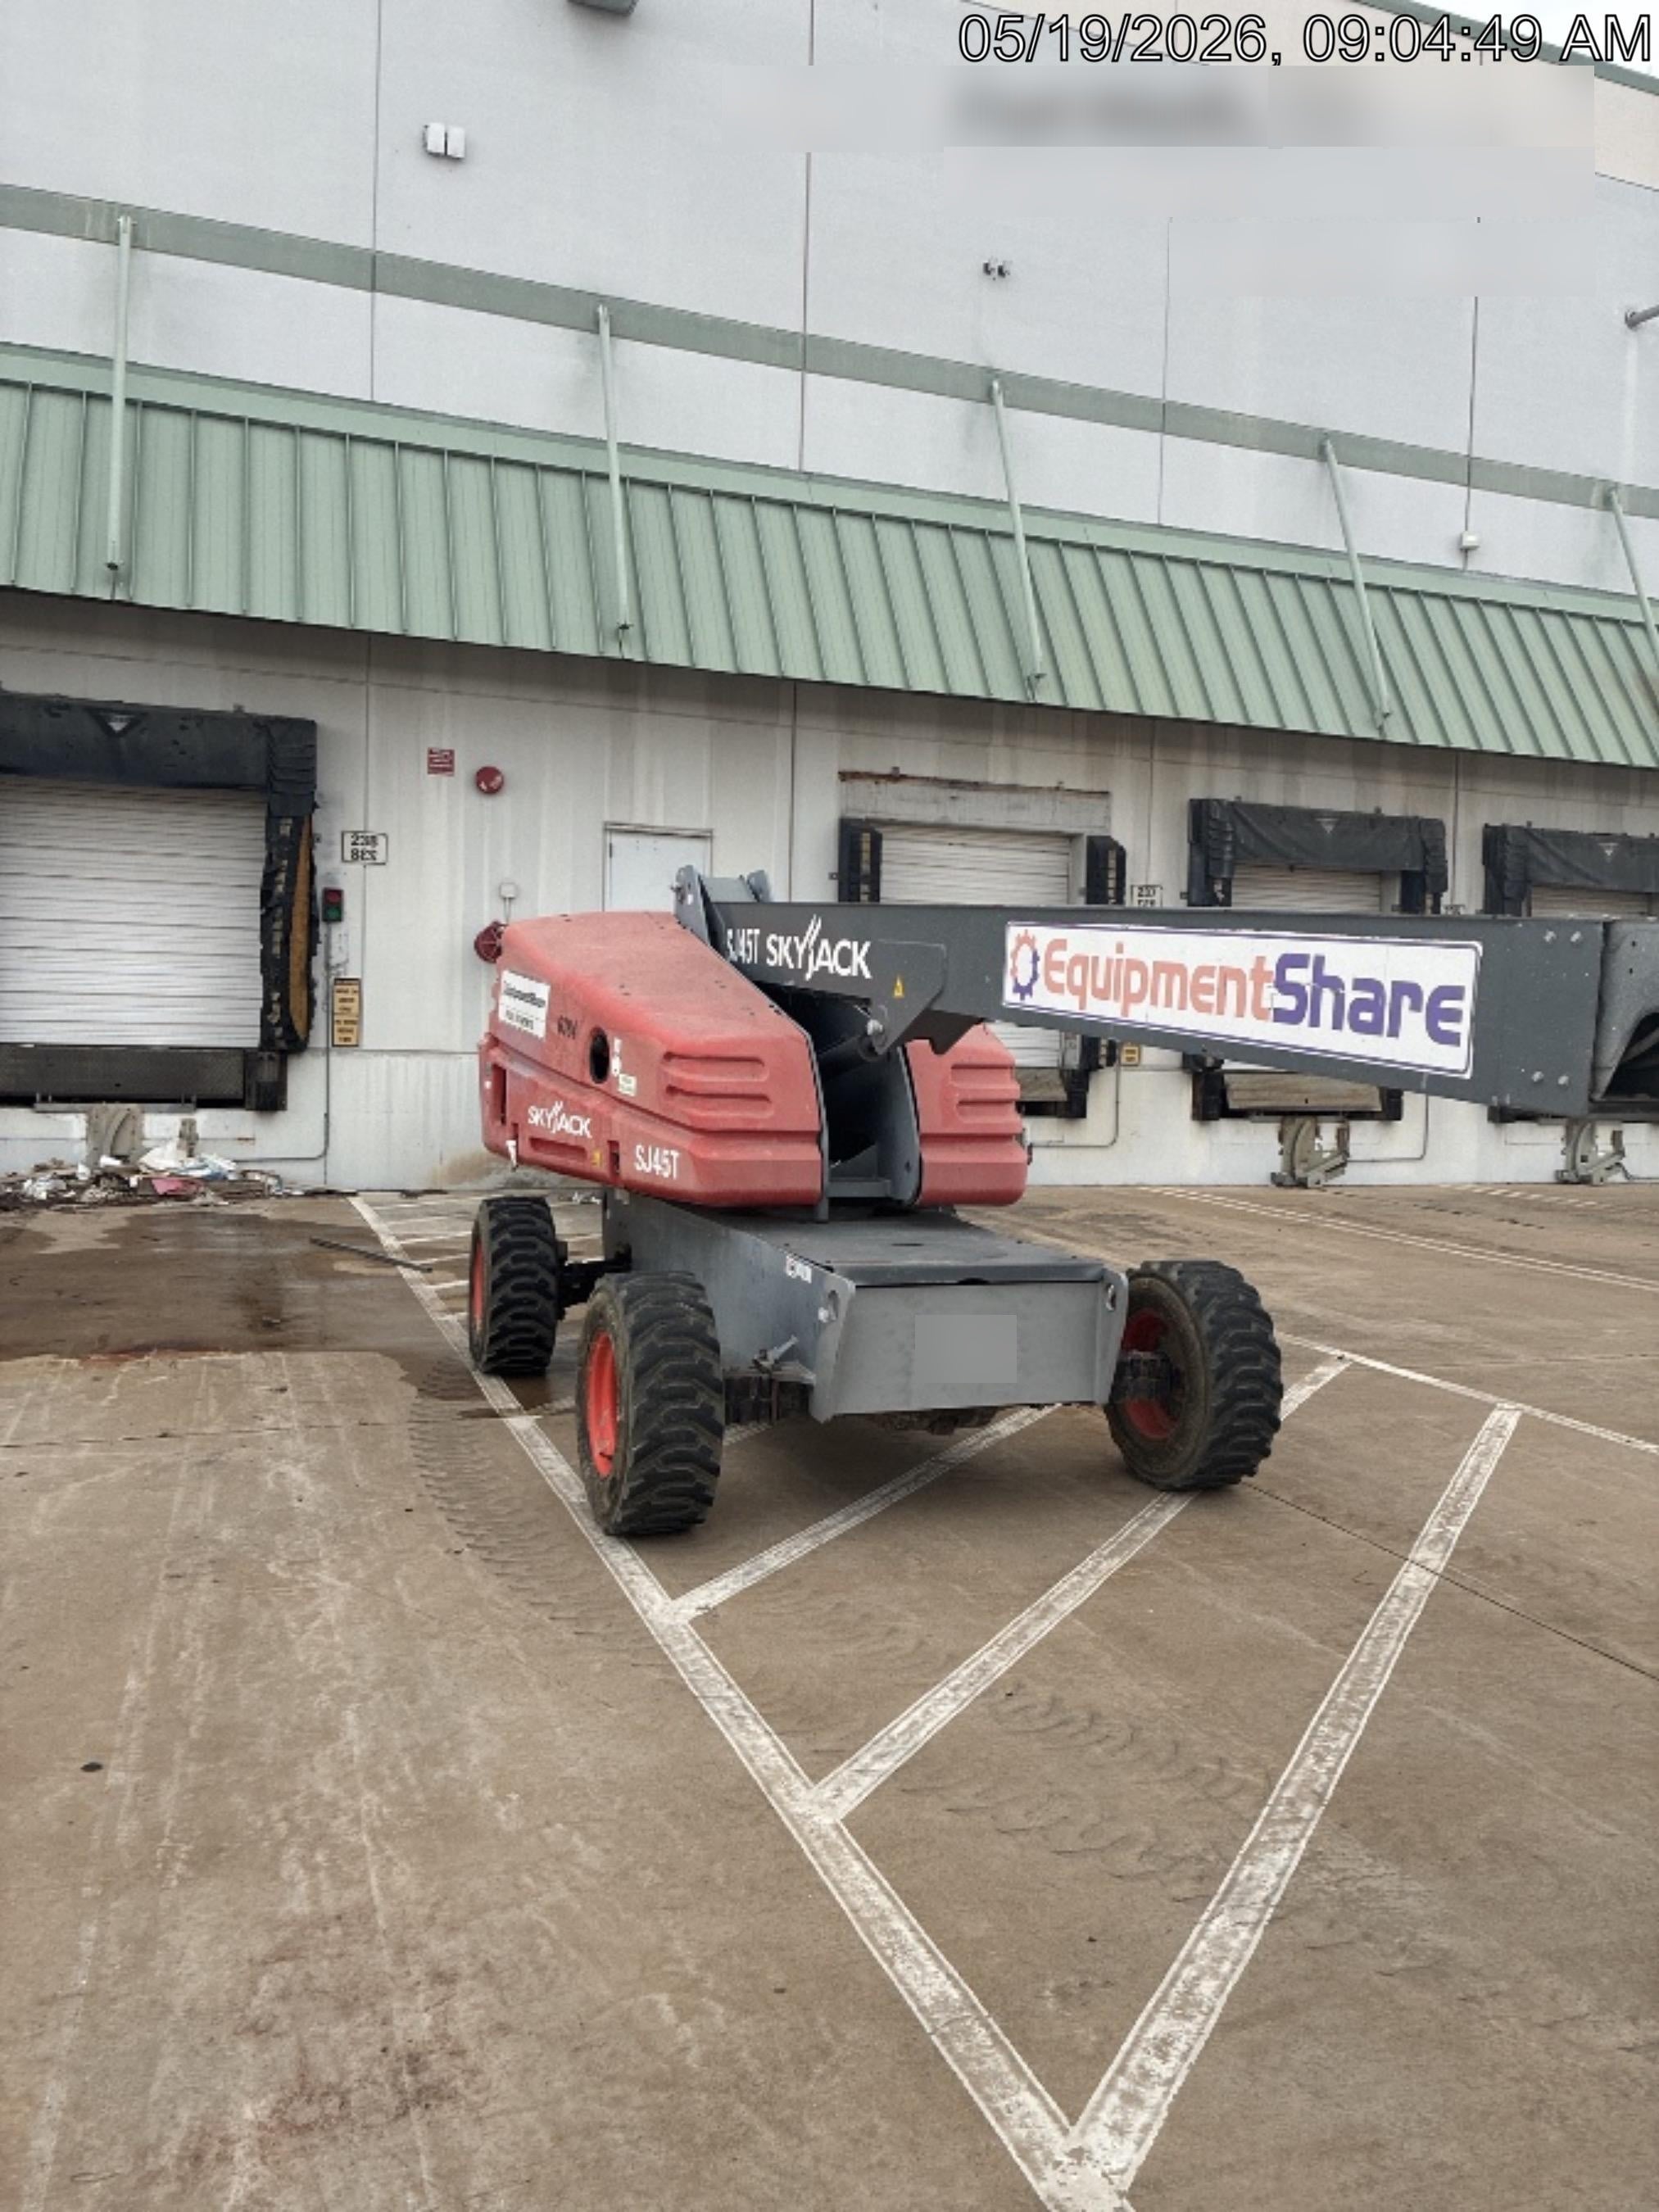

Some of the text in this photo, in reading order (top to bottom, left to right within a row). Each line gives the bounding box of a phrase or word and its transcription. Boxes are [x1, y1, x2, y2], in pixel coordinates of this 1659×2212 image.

[765, 913, 873, 981] SKYJACK
[1043, 938, 1466, 1047] EquipmentShare
[528, 1101, 592, 1139] SKYJACK
[634, 1144, 680, 1179] SJ45T
